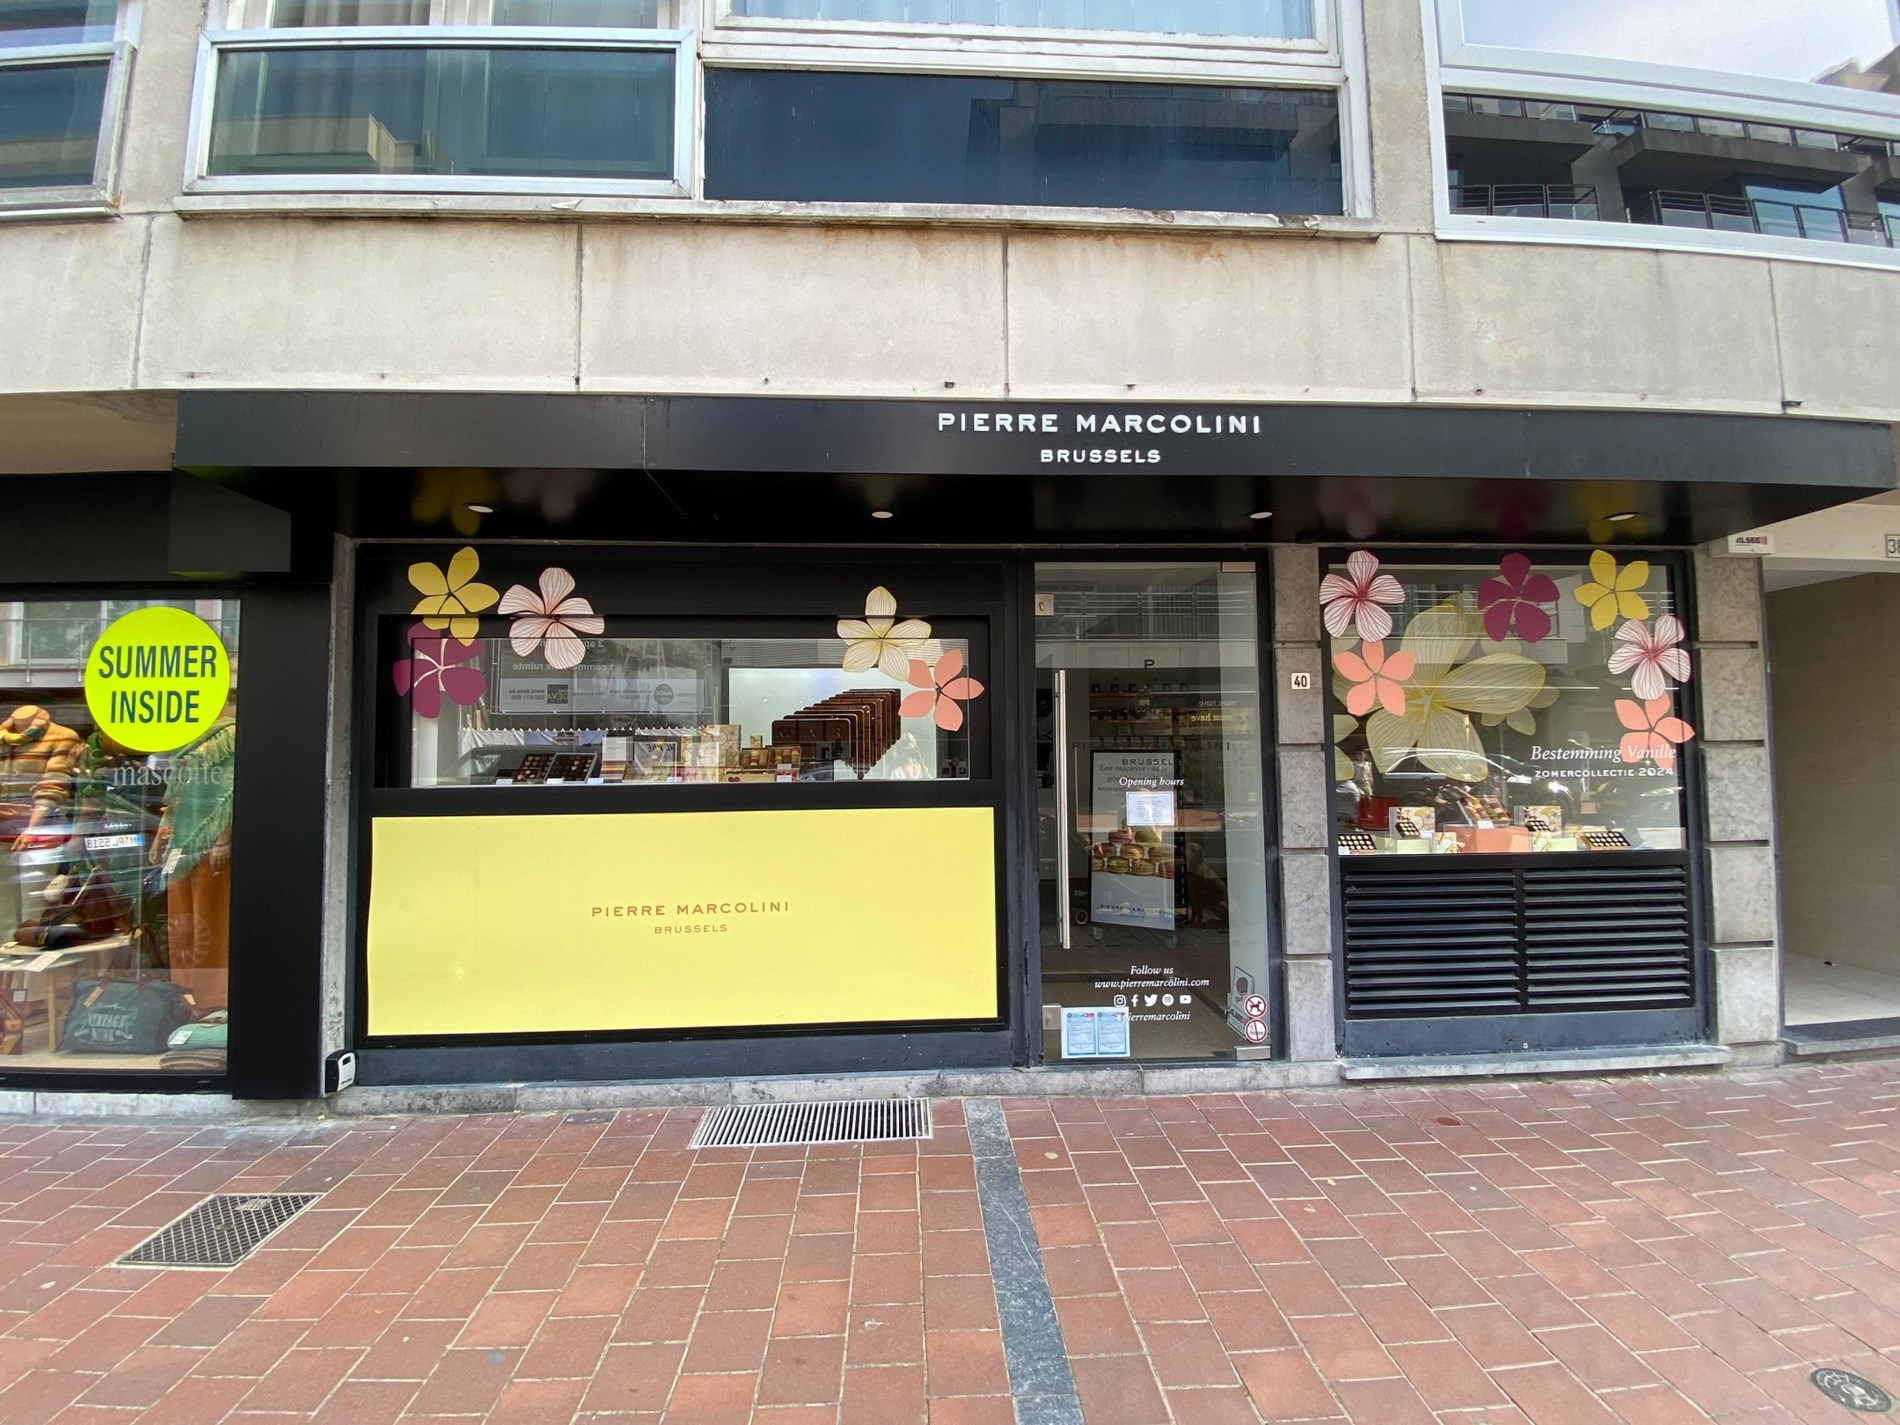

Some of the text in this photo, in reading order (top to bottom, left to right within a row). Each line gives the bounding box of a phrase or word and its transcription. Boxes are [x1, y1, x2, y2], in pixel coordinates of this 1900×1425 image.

[938, 412, 1261, 434] PIERRE MARCOLINI
[1040, 450, 1161, 463] BRUSSELS
[98, 645, 217, 678] SUMMER
[1294, 675, 1307, 688] 40
[110, 690, 200, 724] INSIDE
[1531, 744, 1676, 763] Bestemming Vanille
[1535, 768, 1674, 778] ZOMERCOLLECTIE 2024
[1119, 776, 1157, 787] Opening
[1159, 776, 1184, 786] hours
[592, 901, 788, 917] PIERRE MARCOLINI
[654, 924, 728, 934] BRUSSELS
[1130, 966, 1174, 975] Follow us
[1094, 978, 1210, 989] www.pierremarcolini.com
